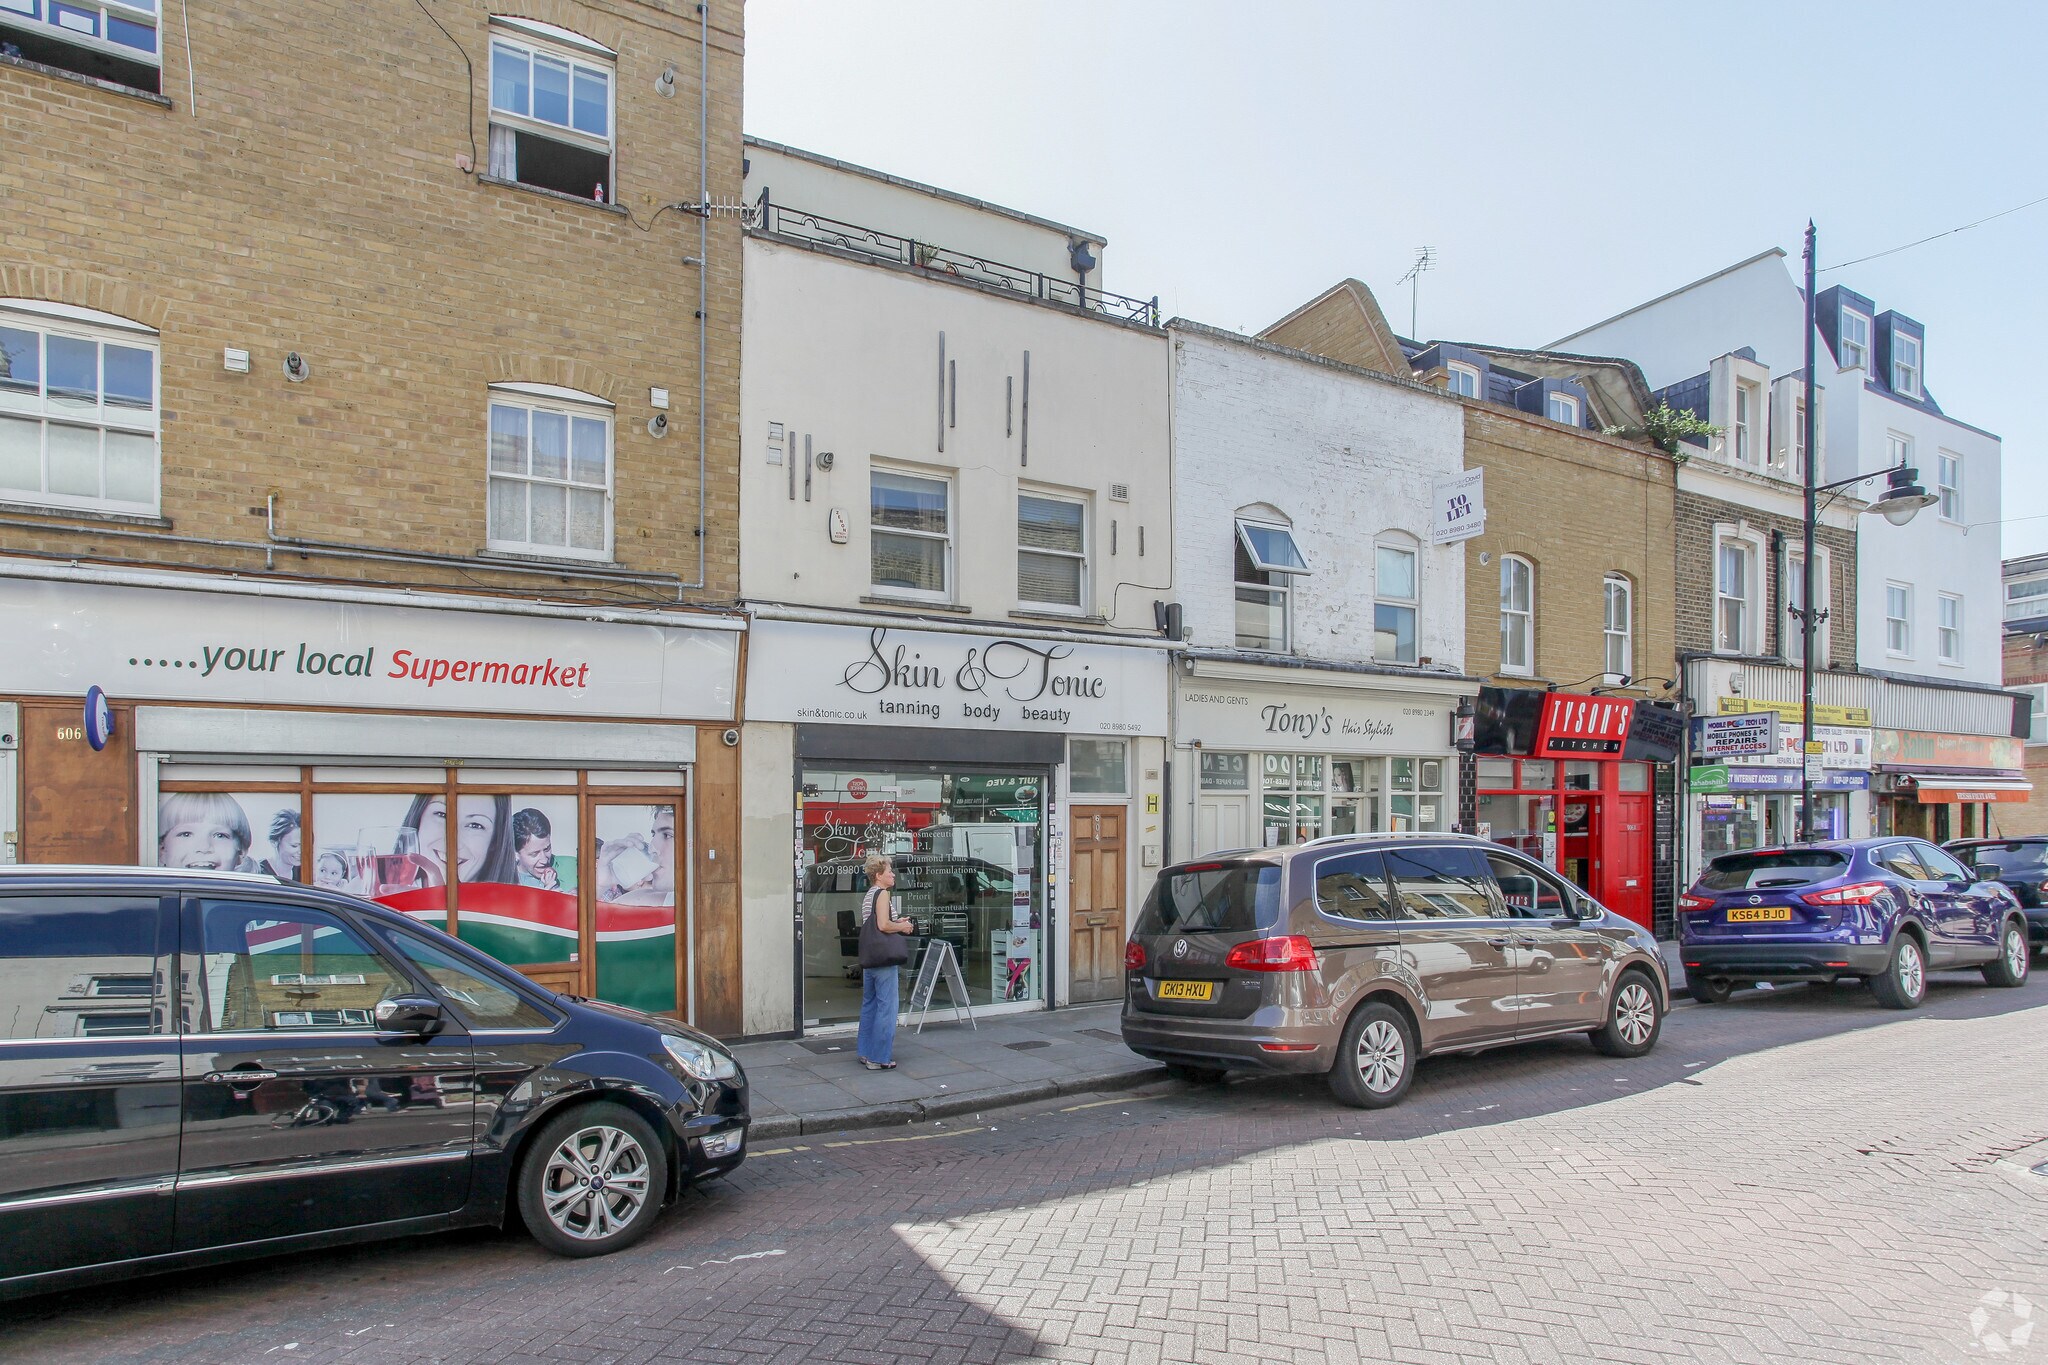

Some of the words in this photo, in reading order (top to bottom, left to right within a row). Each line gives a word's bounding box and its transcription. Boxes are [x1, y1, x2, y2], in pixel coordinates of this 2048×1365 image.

[1448, 494, 1466, 509] TO
[1446, 502, 1472, 522] LET
[1450, 526, 1464, 534] 8980
[1466, 521, 1481, 529] 3480
[296, 642, 374, 677] local
[388, 650, 589, 688] Supermarket
[836, 628, 945, 693] Skin
[956, 648, 988, 697] &
[984, 641, 1106, 702] Tonic
[1185, 694, 1208, 703] LADIES
[1226, 696, 1248, 705] GENTS
[797, 708, 868, 720] skin&tonic.co.uk
[880, 699, 940, 719] tanning
[964, 703, 1000, 722] body
[1022, 706, 1070, 724] beauty
[1412, 708, 1423, 716] 8980
[1261, 703, 1333, 739] Tony's
[1550, 700, 1628, 735] TYSON'S
[1342, 718, 1360, 735] Hair
[1363, 719, 1394, 740] Stylists
[1708, 721, 1726, 729] MOBILE
[58, 728, 81, 740] 606
[1729, 730, 1751, 738] PHONES
[1549, 740, 1619, 750] KITCHEN
[1716, 737, 1757, 745] REPAIRS
[1834, 741, 1848, 753] LTD
[1734, 774, 1758, 783] INTERNET
[1758, 775, 1777, 783] ACCESS
[1784, 776, 1793, 784] FAX
[812, 810, 858, 839] Skin
[907, 854, 944, 863] Diamond
[817, 866, 834, 875] 020
[837, 866, 859, 874] 8980
[906, 867, 922, 875] MD
[926, 866, 977, 874] Formulations
[907, 880, 932, 889] Vitage
[907, 892, 930, 900] Priori
[929, 902, 968, 911] Escentuals
[1732, 911, 1760, 919] KS64
[1764, 910, 1785, 918] BJO
[1164, 982, 1184, 995] GK13
[1185, 983, 1206, 996] HXU
